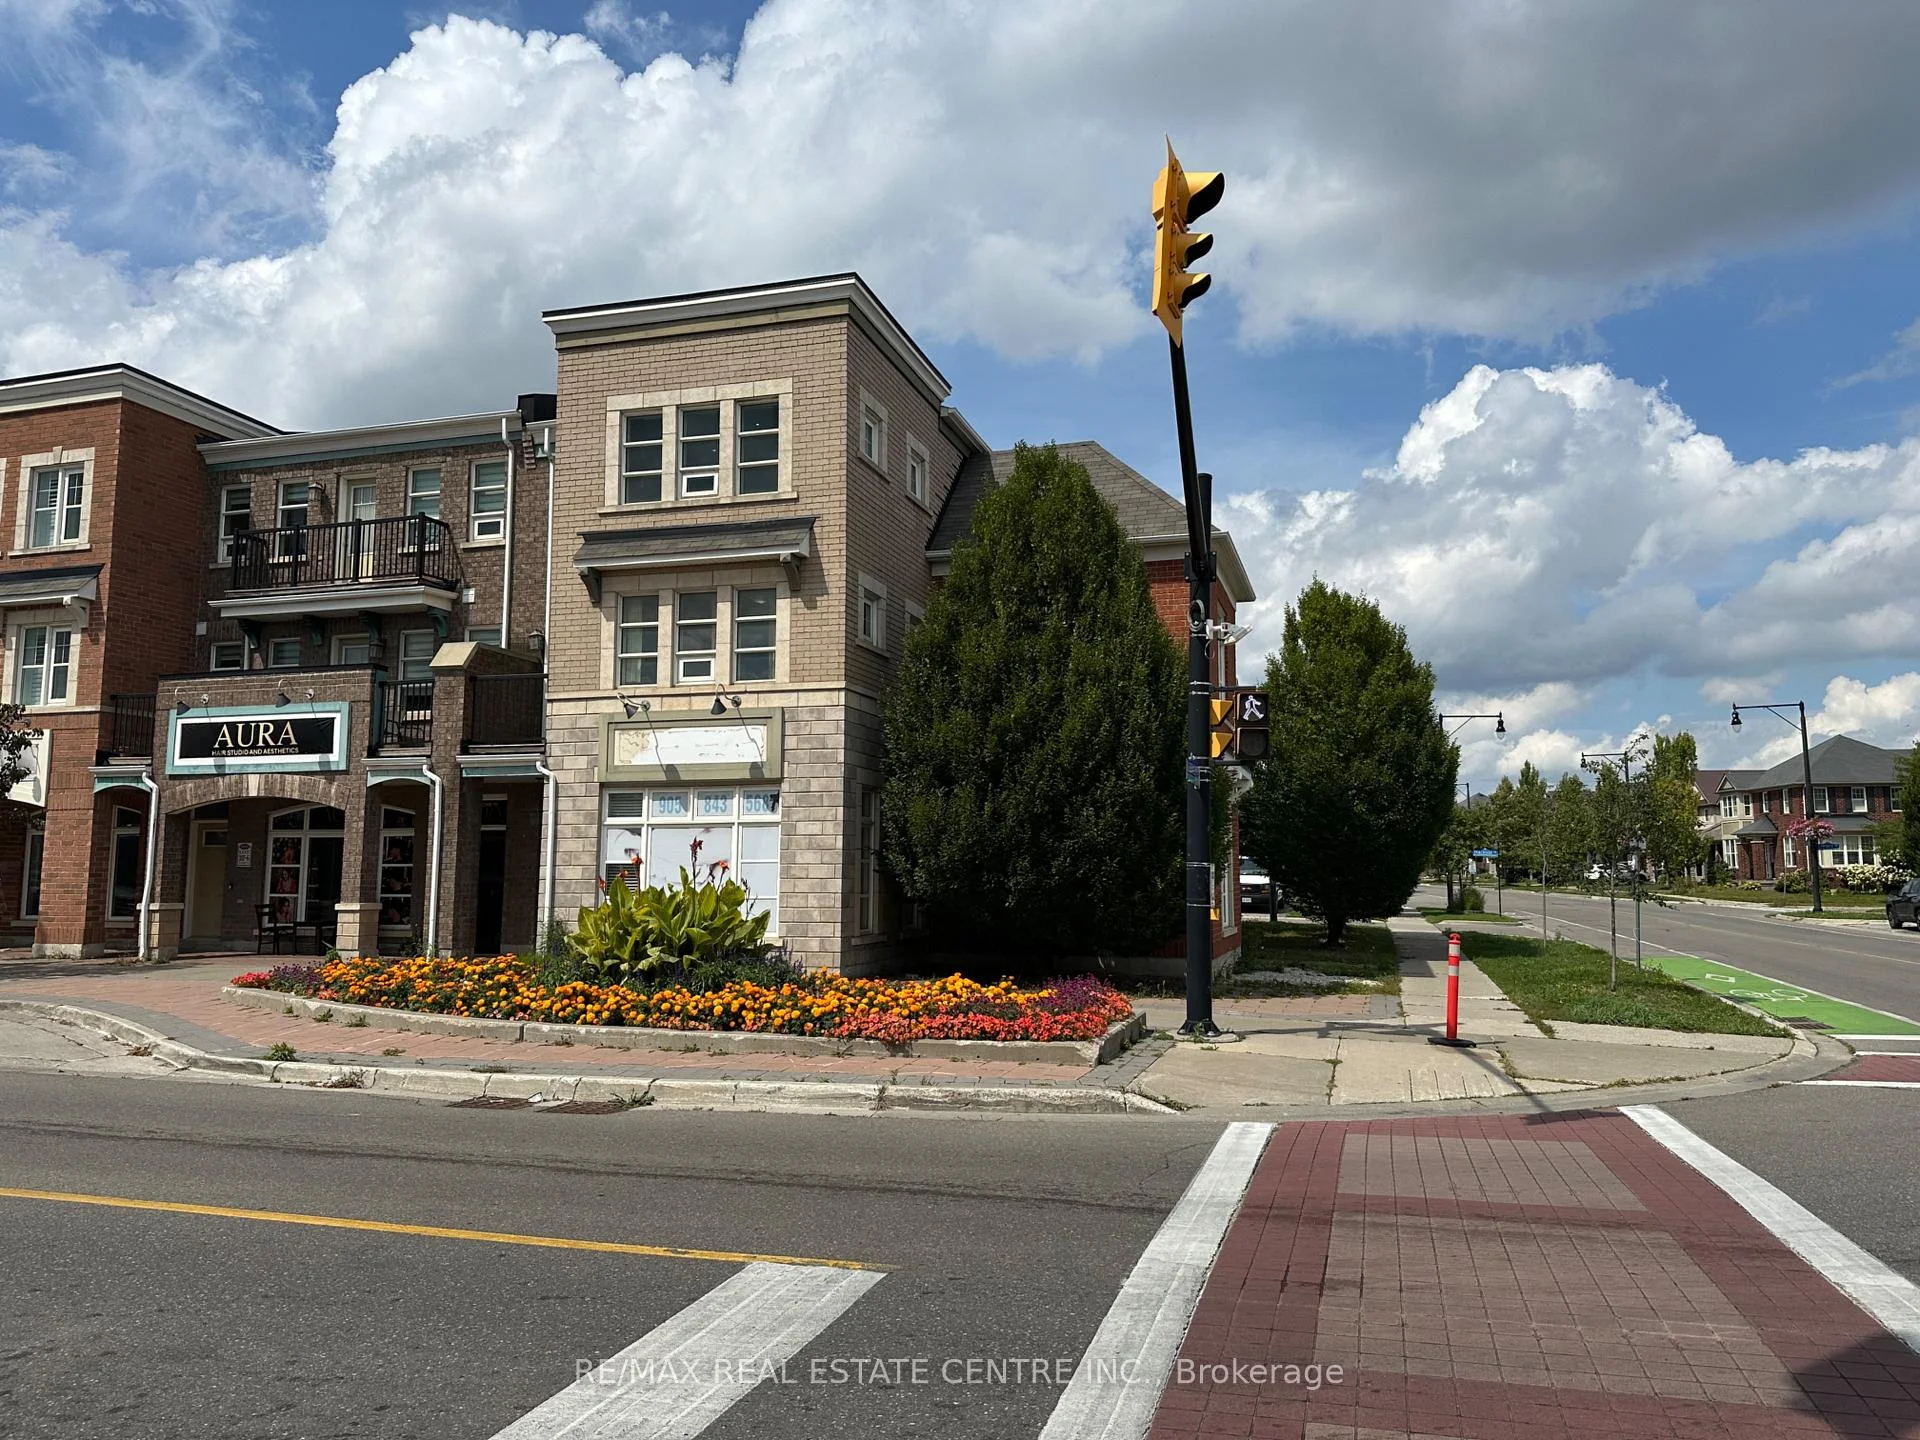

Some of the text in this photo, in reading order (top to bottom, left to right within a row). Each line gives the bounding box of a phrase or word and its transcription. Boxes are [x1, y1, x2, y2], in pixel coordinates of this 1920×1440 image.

[213, 721, 298, 748] AURA
[263, 747, 299, 755] AESTHETICS
[659, 796, 682, 814] 905
[704, 794, 727, 813] 843
